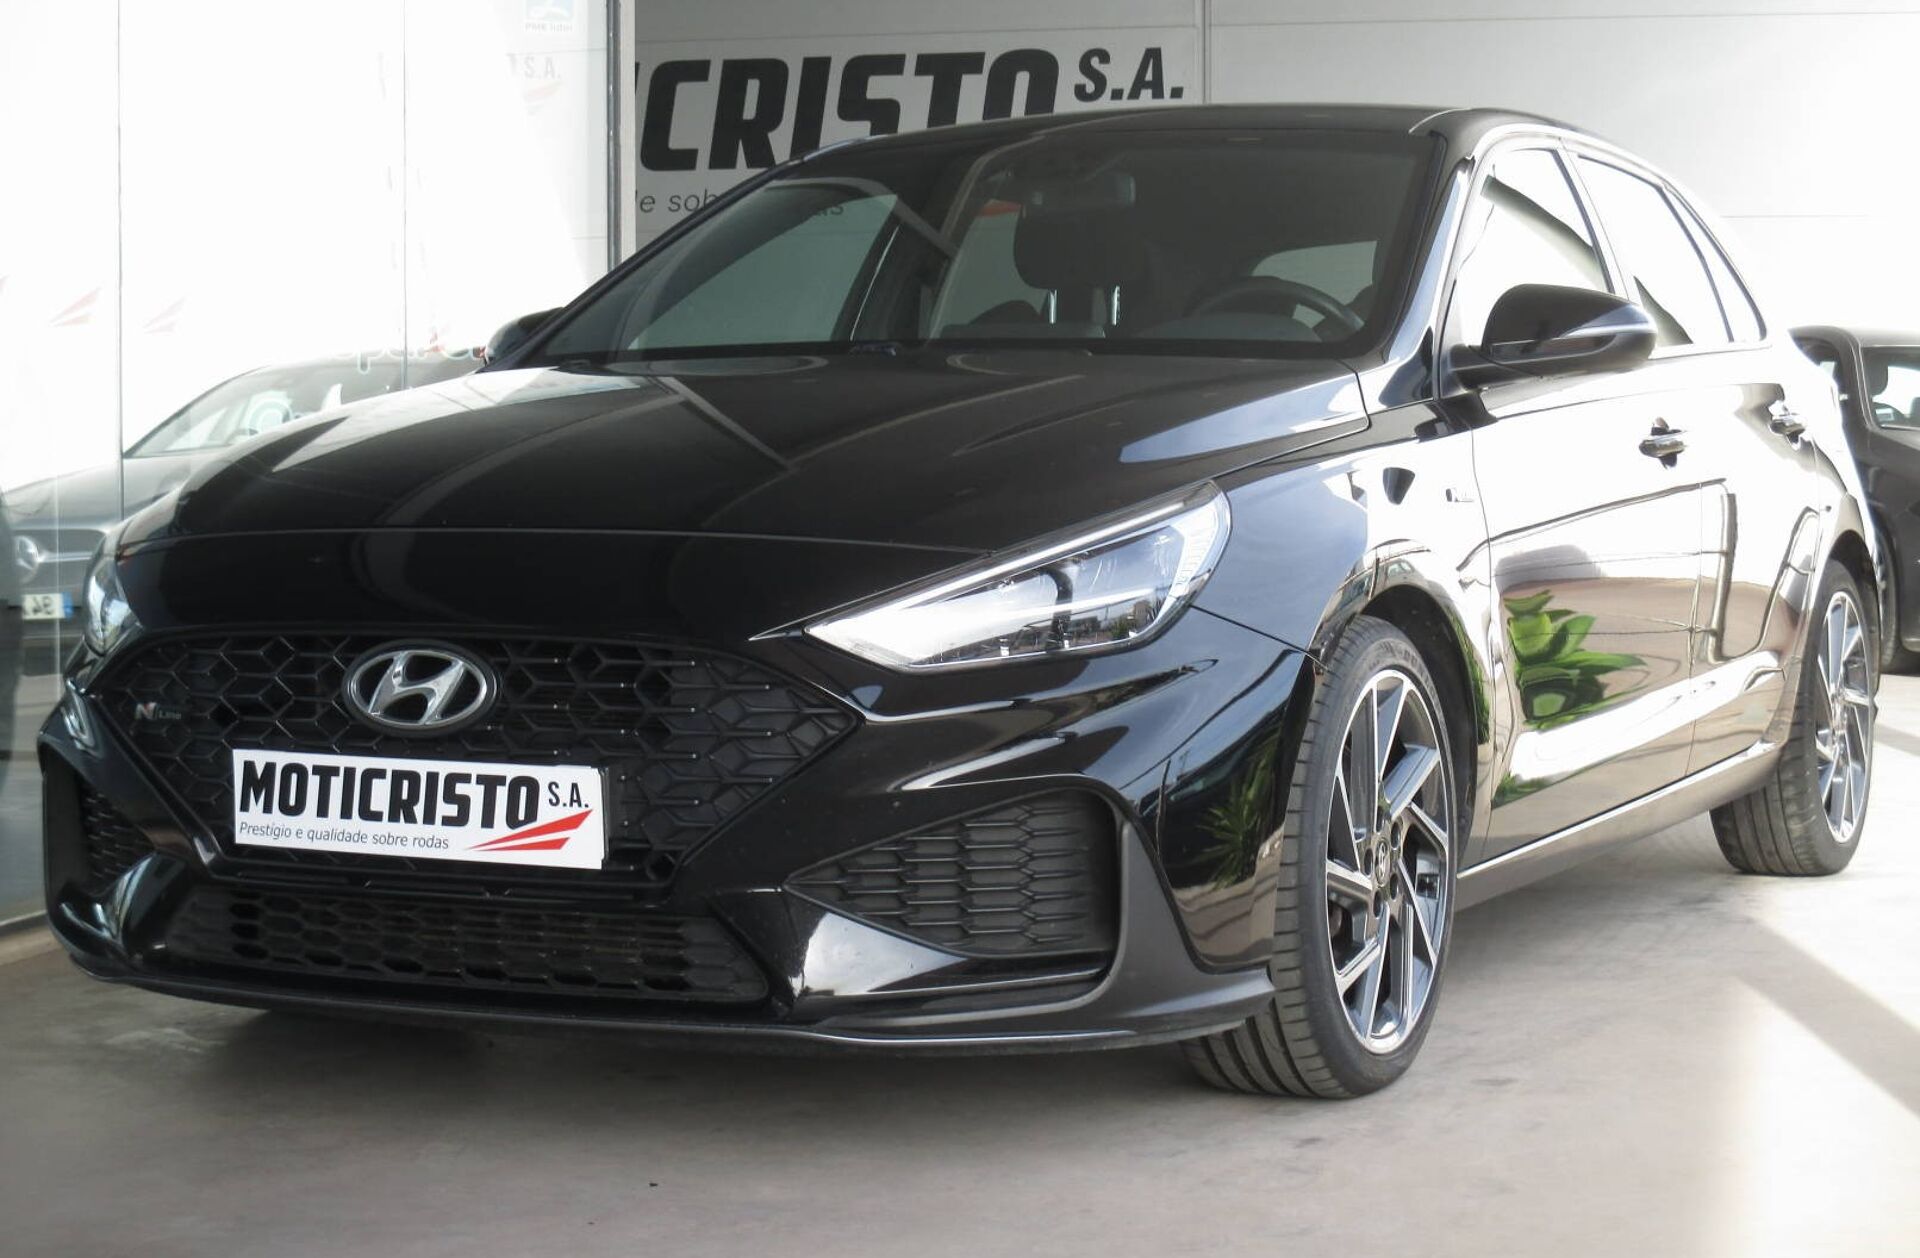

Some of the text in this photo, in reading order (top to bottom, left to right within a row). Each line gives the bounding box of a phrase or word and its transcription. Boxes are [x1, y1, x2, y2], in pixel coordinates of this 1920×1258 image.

[635, 46, 1184, 172] CRISTO S.A.
[239, 760, 590, 831] MOTICRISTO S.A.
[295, 827, 304, 839] e
[306, 827, 368, 845] qualidade
[372, 832, 408, 847] sobre
[412, 835, 449, 850] rodas
